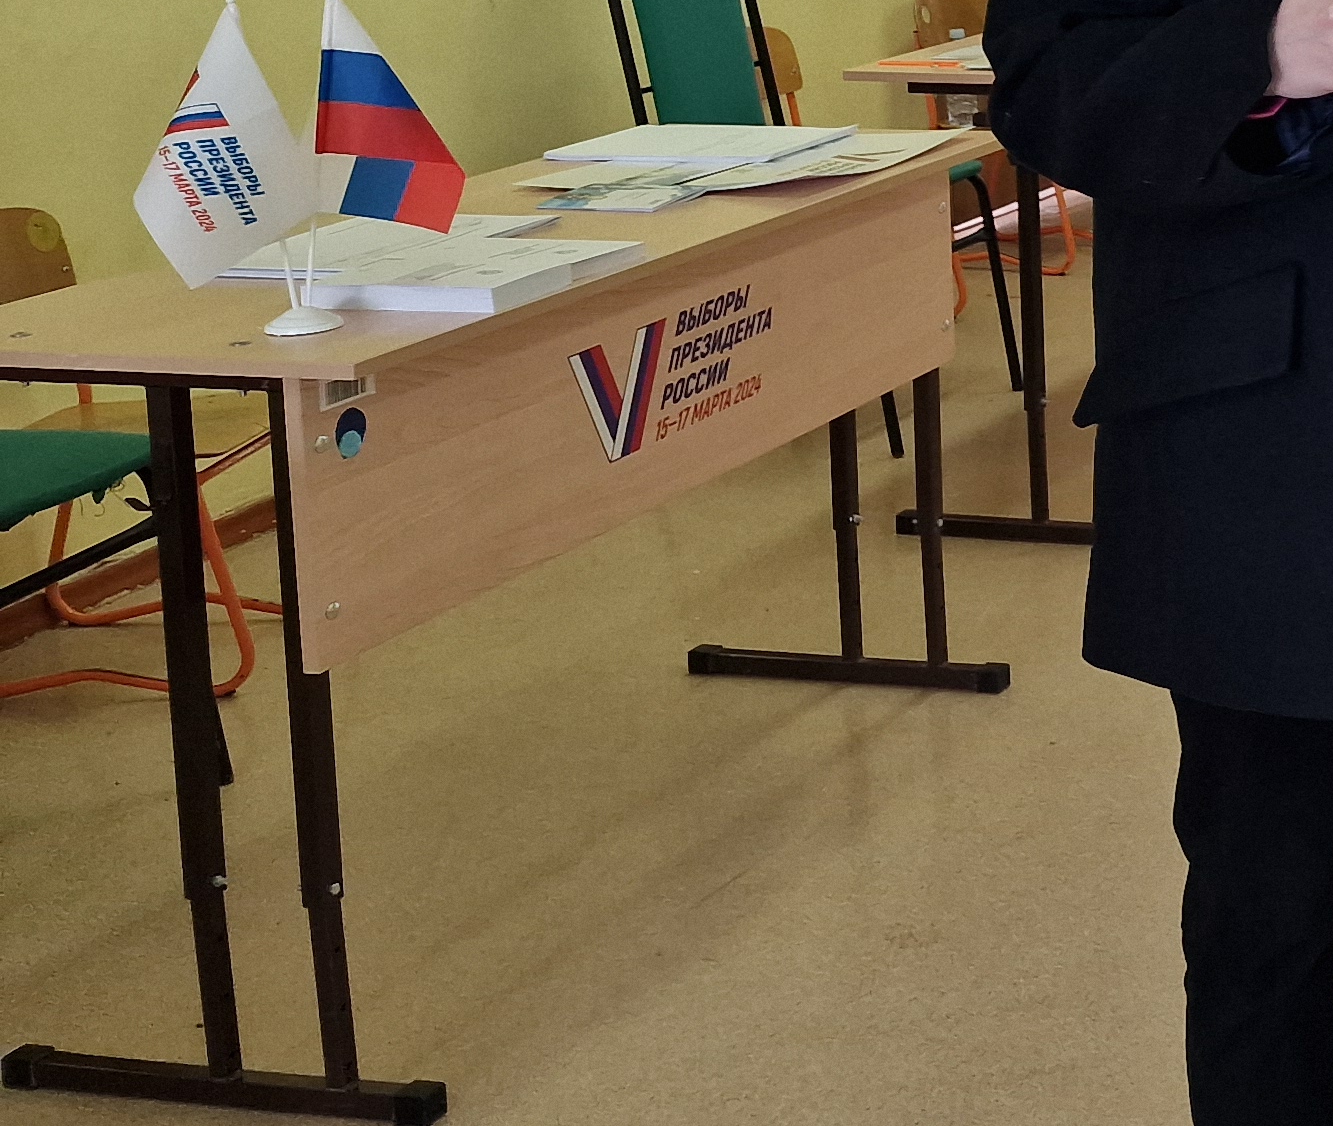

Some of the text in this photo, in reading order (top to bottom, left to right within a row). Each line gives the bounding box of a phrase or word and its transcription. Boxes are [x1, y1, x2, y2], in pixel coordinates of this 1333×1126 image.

[172, 141, 221, 196] РОССИИ
[196, 139, 258, 226] ПРЕЗИДЕНТА
[220, 136, 265, 196] ВЫБОРЫ
[168, 173, 202, 207] МАРТА
[191, 209, 217, 233] 2024
[675, 284, 750, 337] ВЫБОРЫ
[668, 306, 773, 373] ПРЕЗИДЕНТА
[660, 357, 730, 410] РОССИИ
[690, 390, 731, 425] МАРТА
[733, 373, 763, 405] 2024
